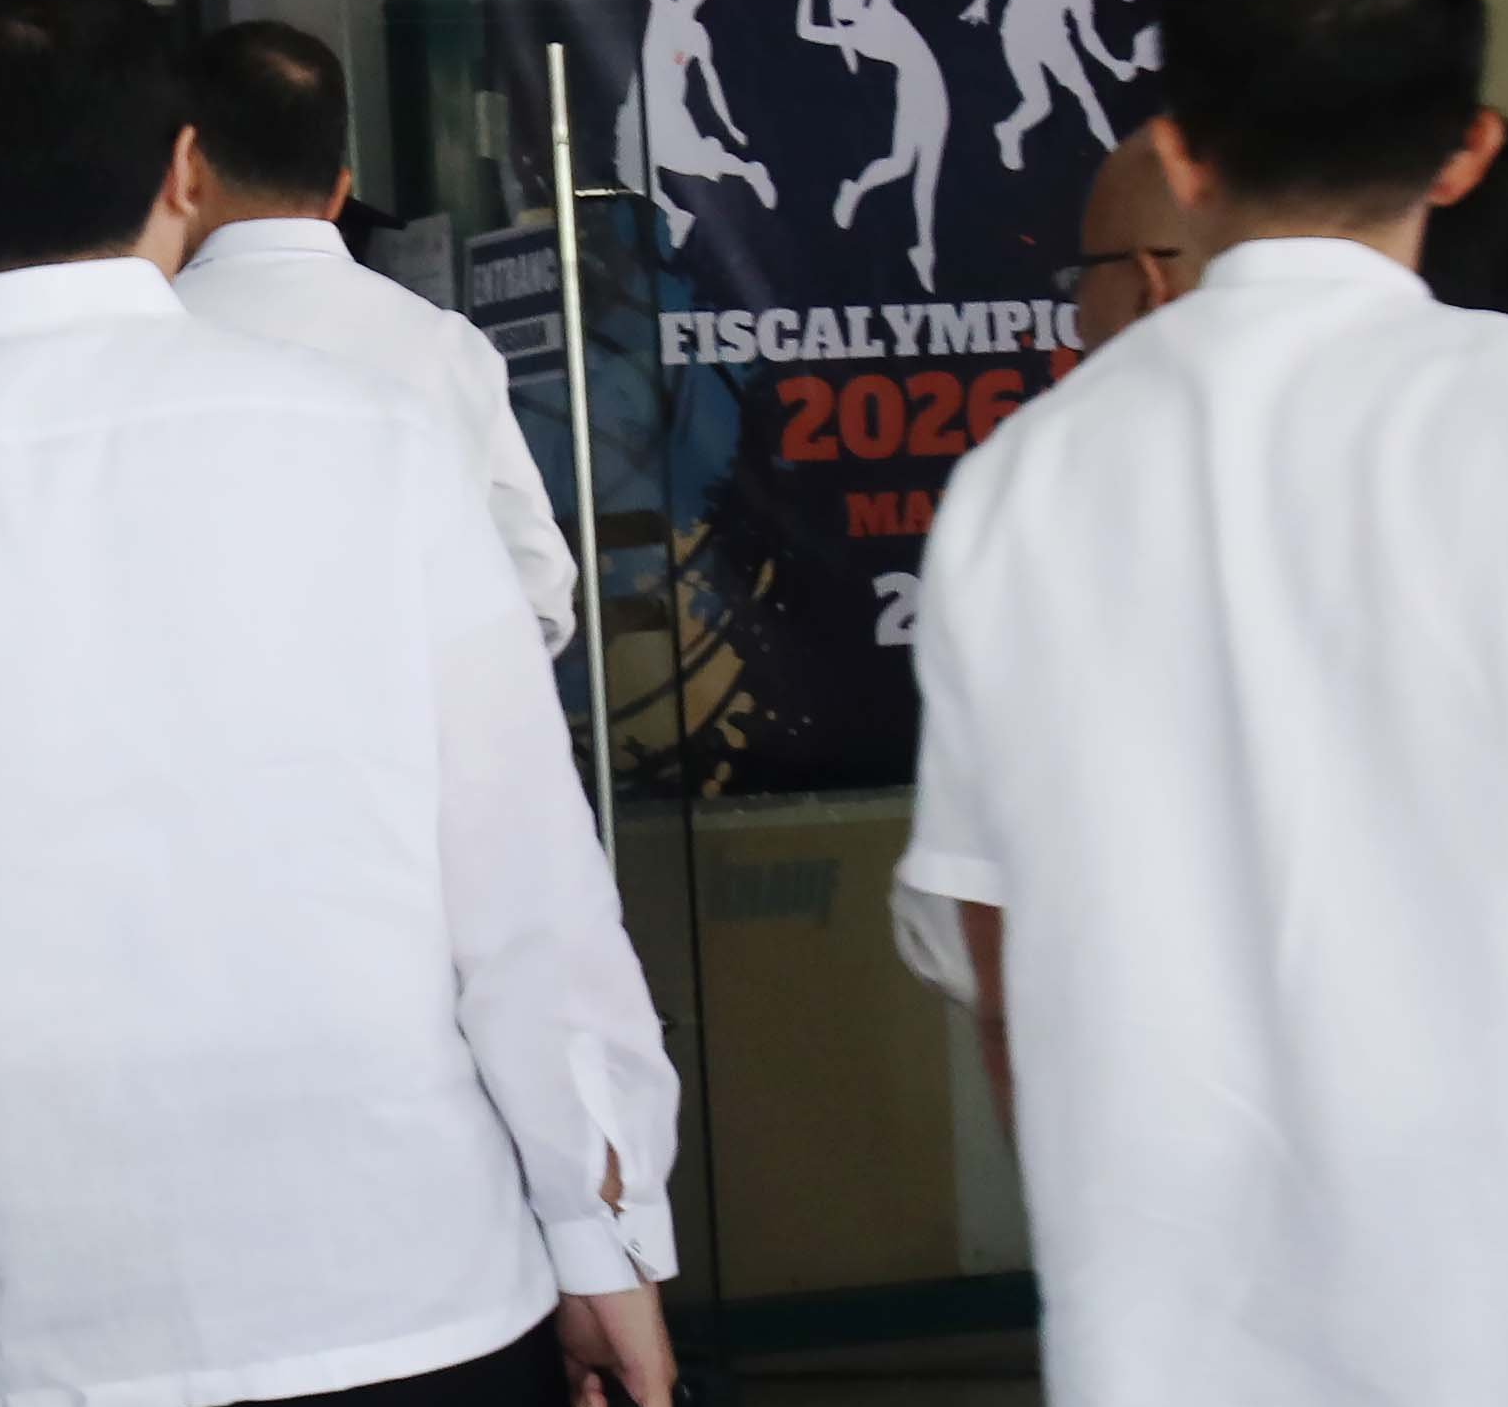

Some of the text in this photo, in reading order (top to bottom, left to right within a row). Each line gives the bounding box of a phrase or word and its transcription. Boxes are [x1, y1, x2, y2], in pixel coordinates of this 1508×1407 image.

[472, 246, 559, 308] ENTRANC
[776, 367, 1025, 462] 2026
[846, 488, 948, 538] MA
